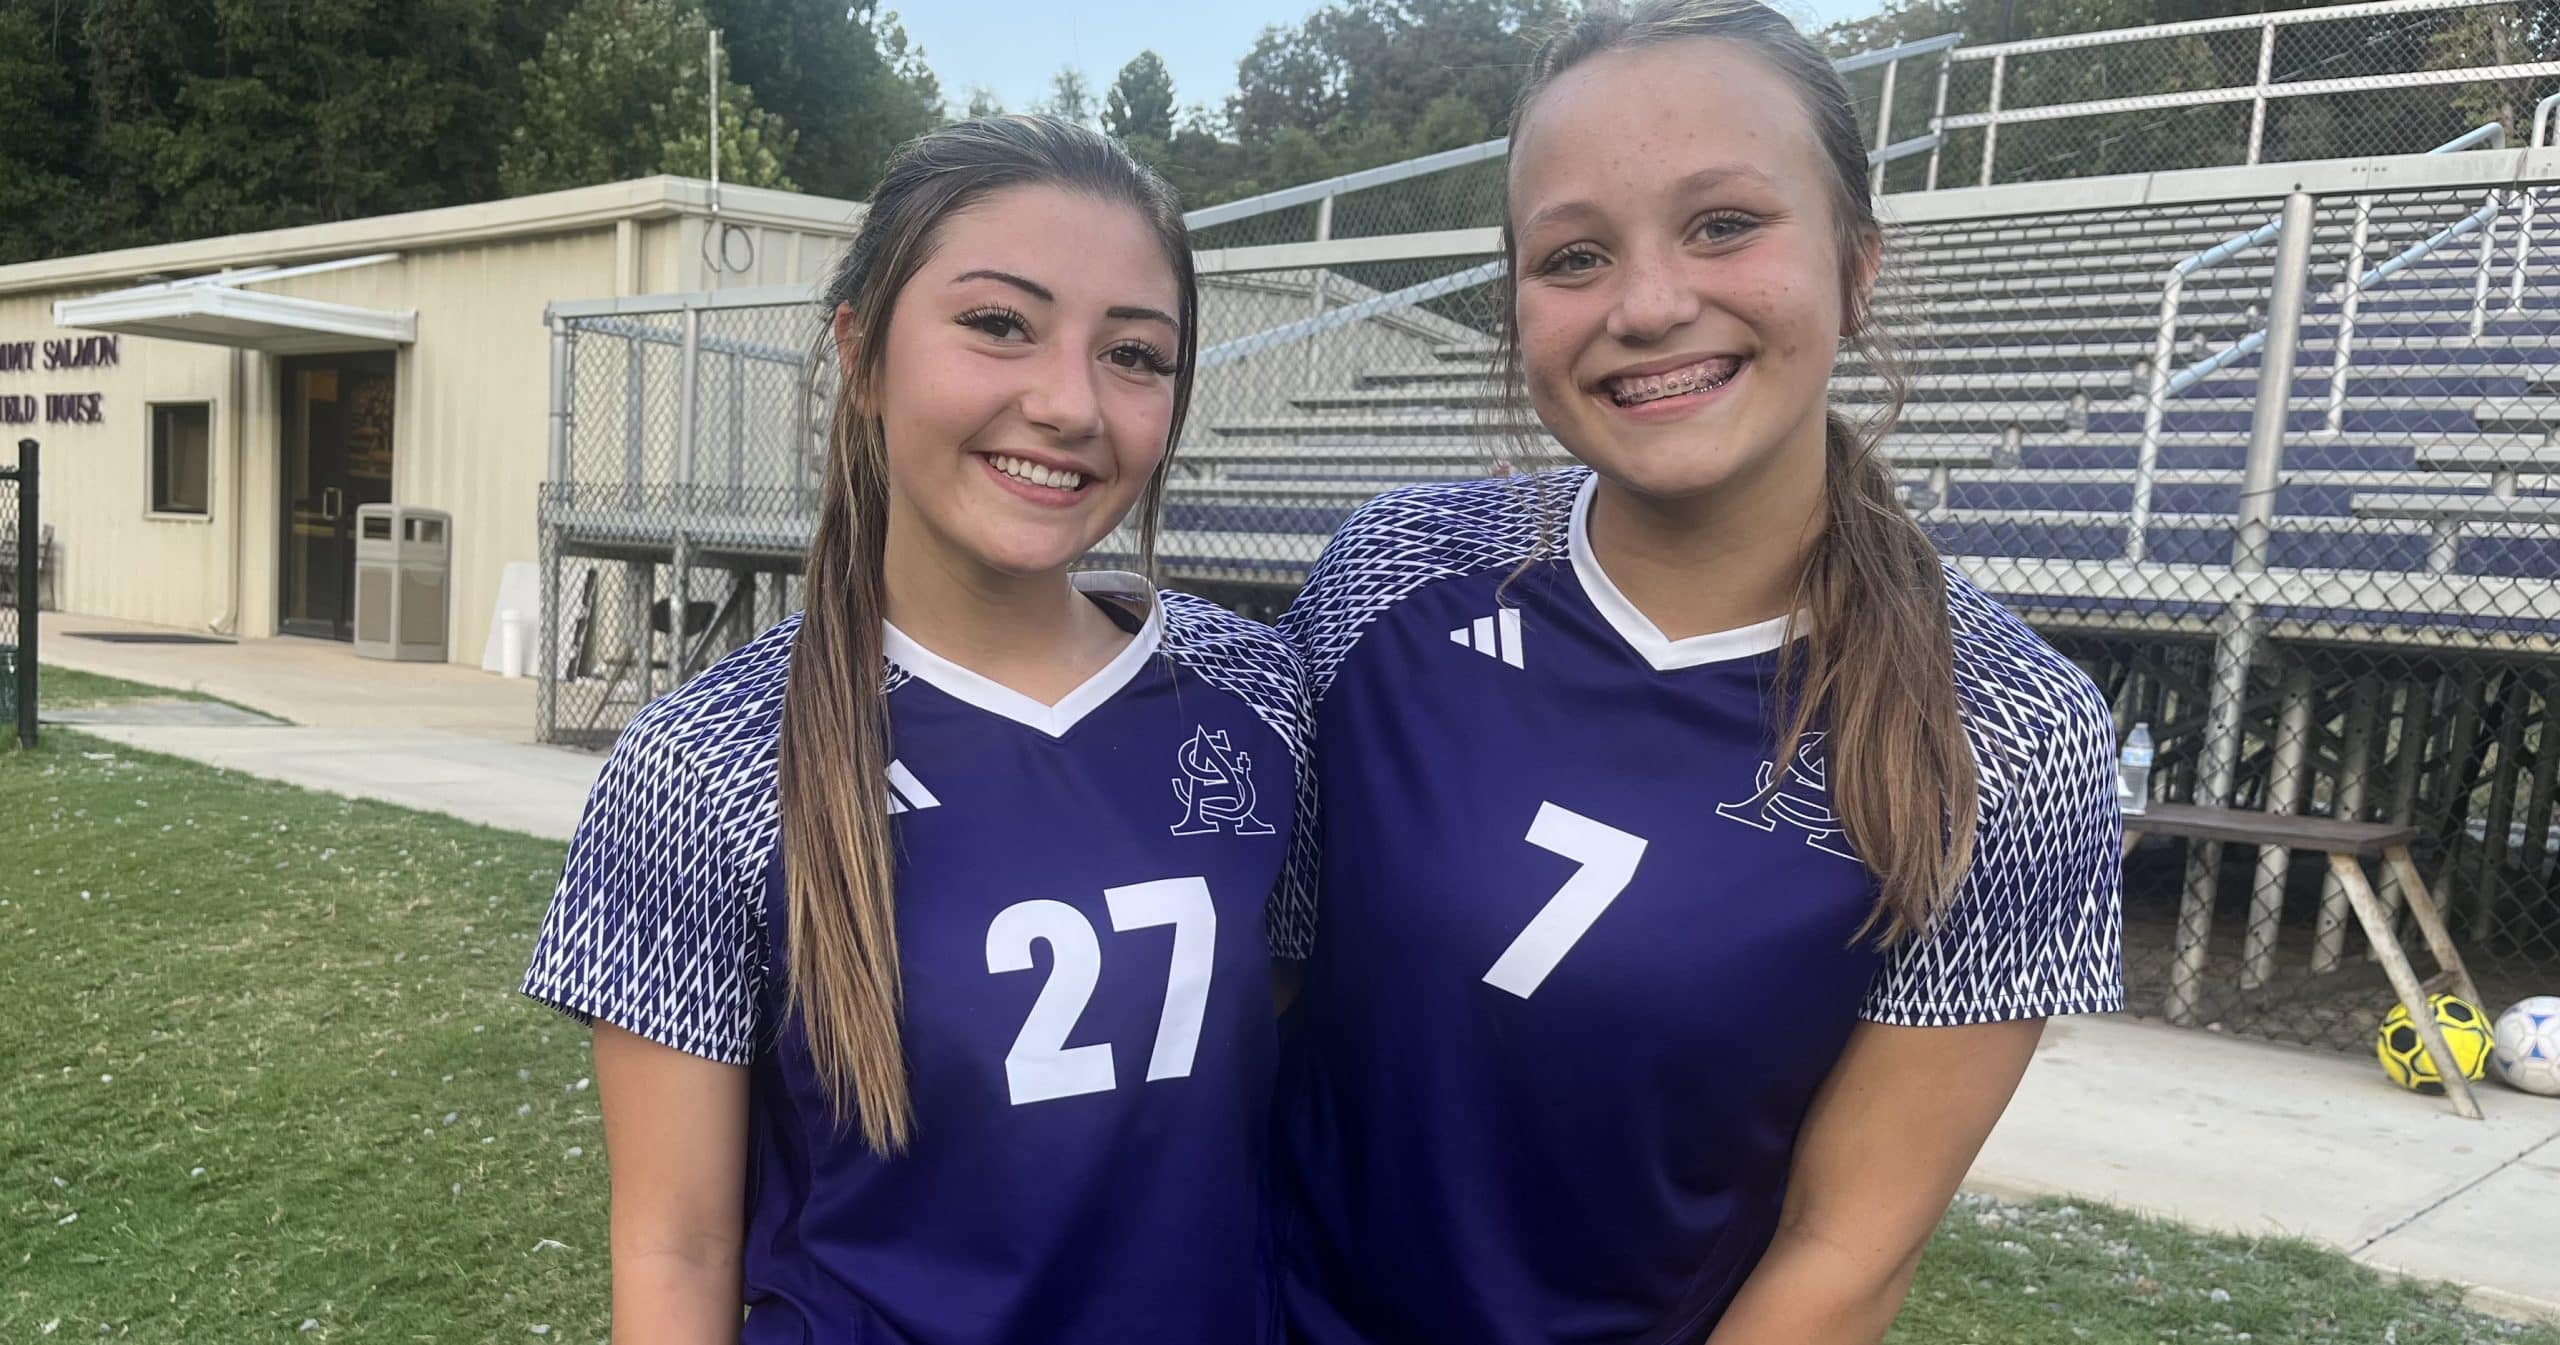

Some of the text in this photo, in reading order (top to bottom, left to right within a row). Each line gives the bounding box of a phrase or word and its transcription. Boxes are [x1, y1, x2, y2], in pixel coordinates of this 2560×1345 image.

[43, 334, 119, 370] SALMON
[46, 392, 103, 424] HOUSE
[1481, 800, 1649, 1000] 7
[985, 876, 1217, 1106] 27
